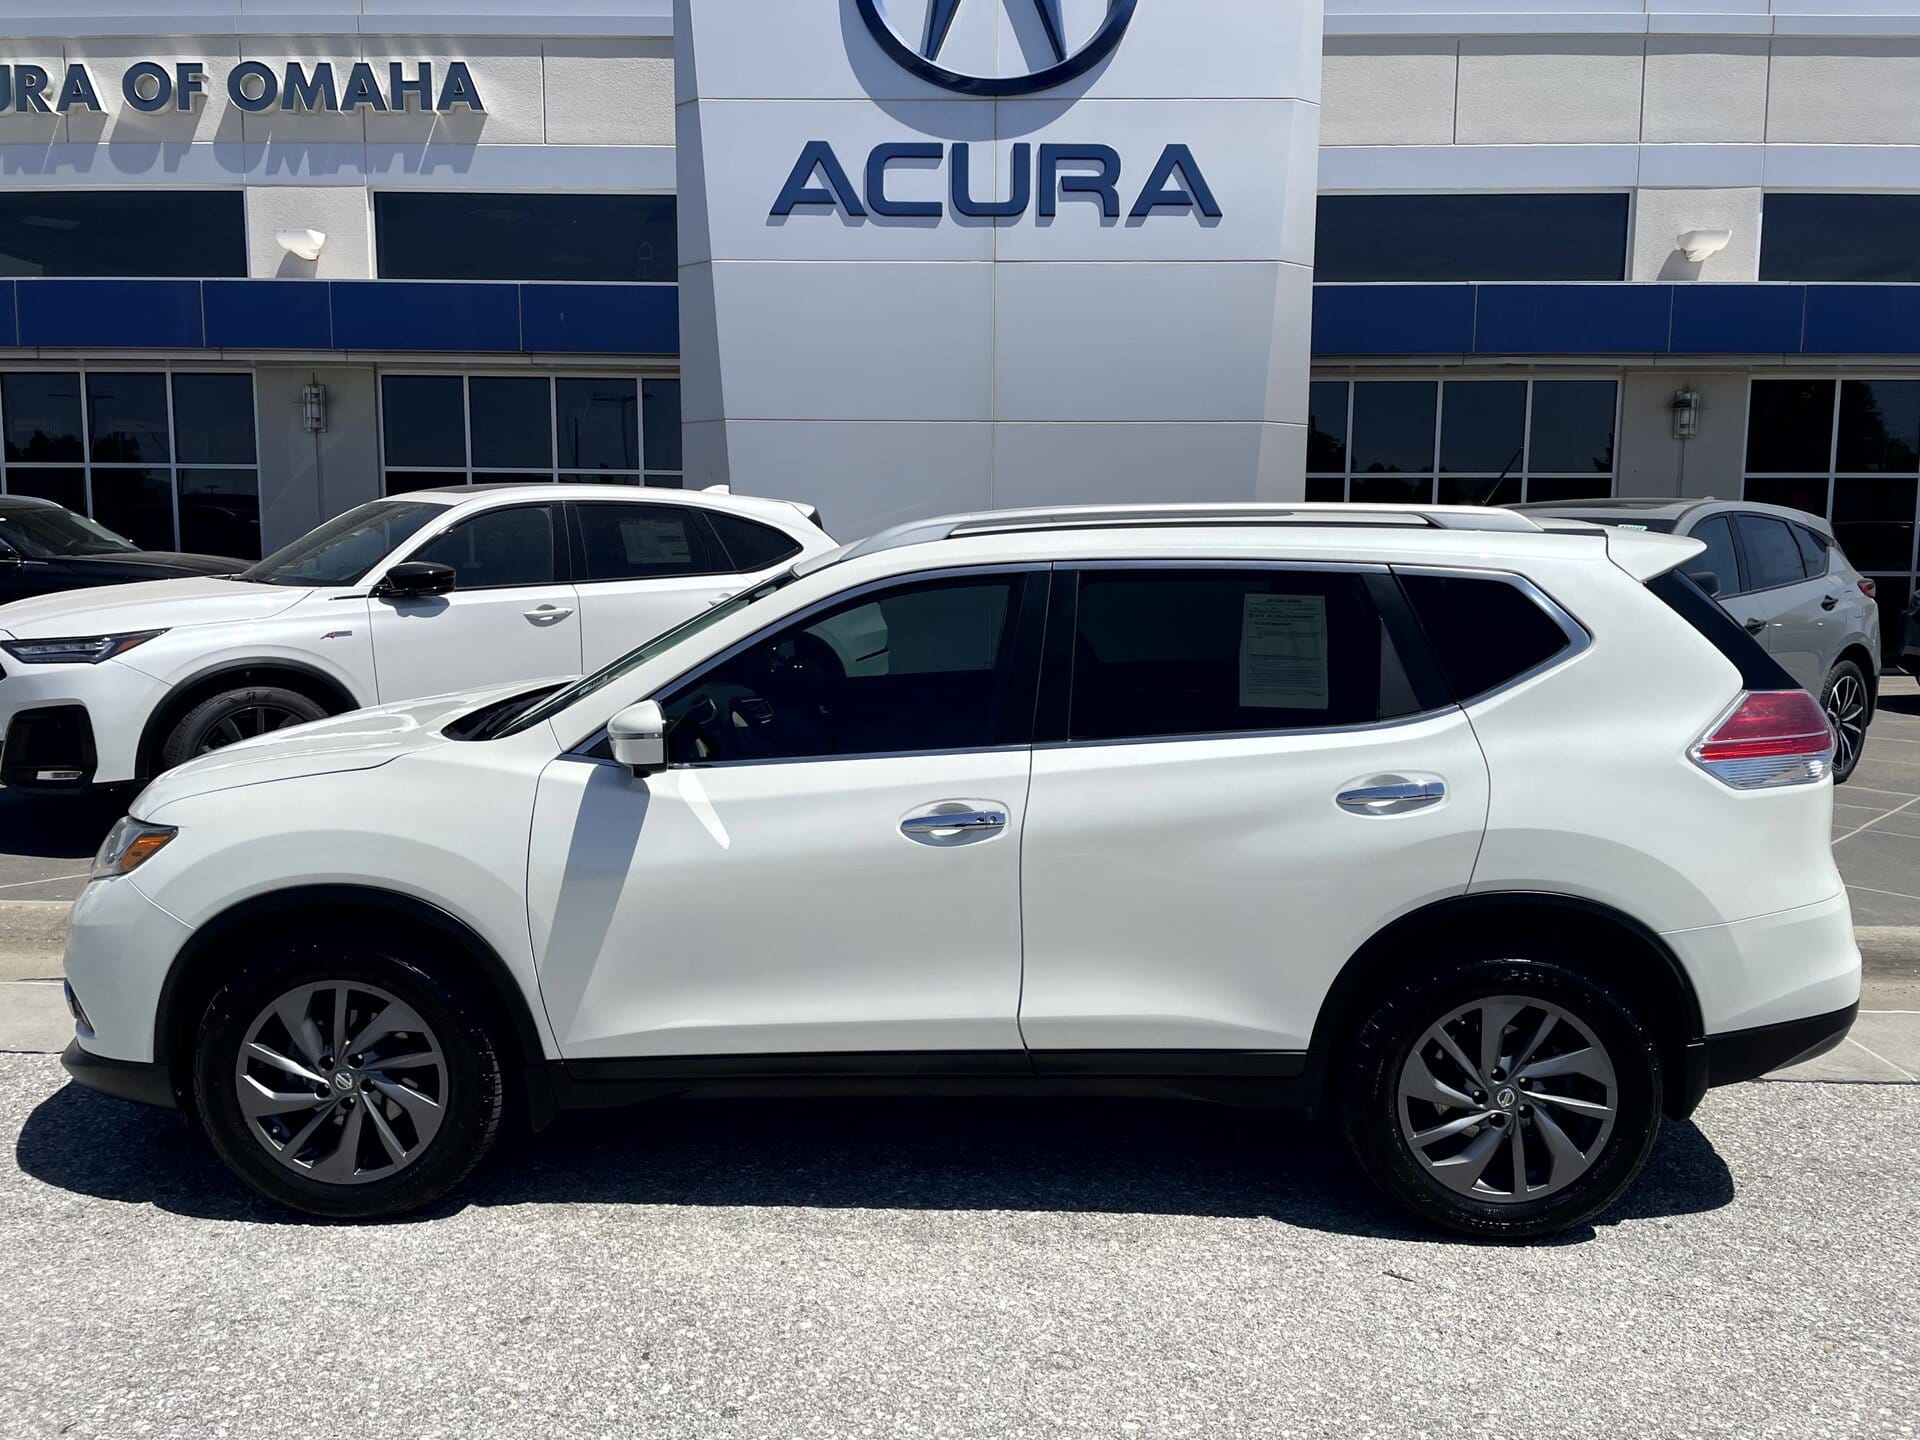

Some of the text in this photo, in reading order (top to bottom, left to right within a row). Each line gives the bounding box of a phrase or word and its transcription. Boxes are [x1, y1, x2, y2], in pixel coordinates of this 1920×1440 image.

[121, 61, 206, 113] OF
[226, 61, 485, 113] OMAHA
[769, 140, 1223, 217] ACURA
